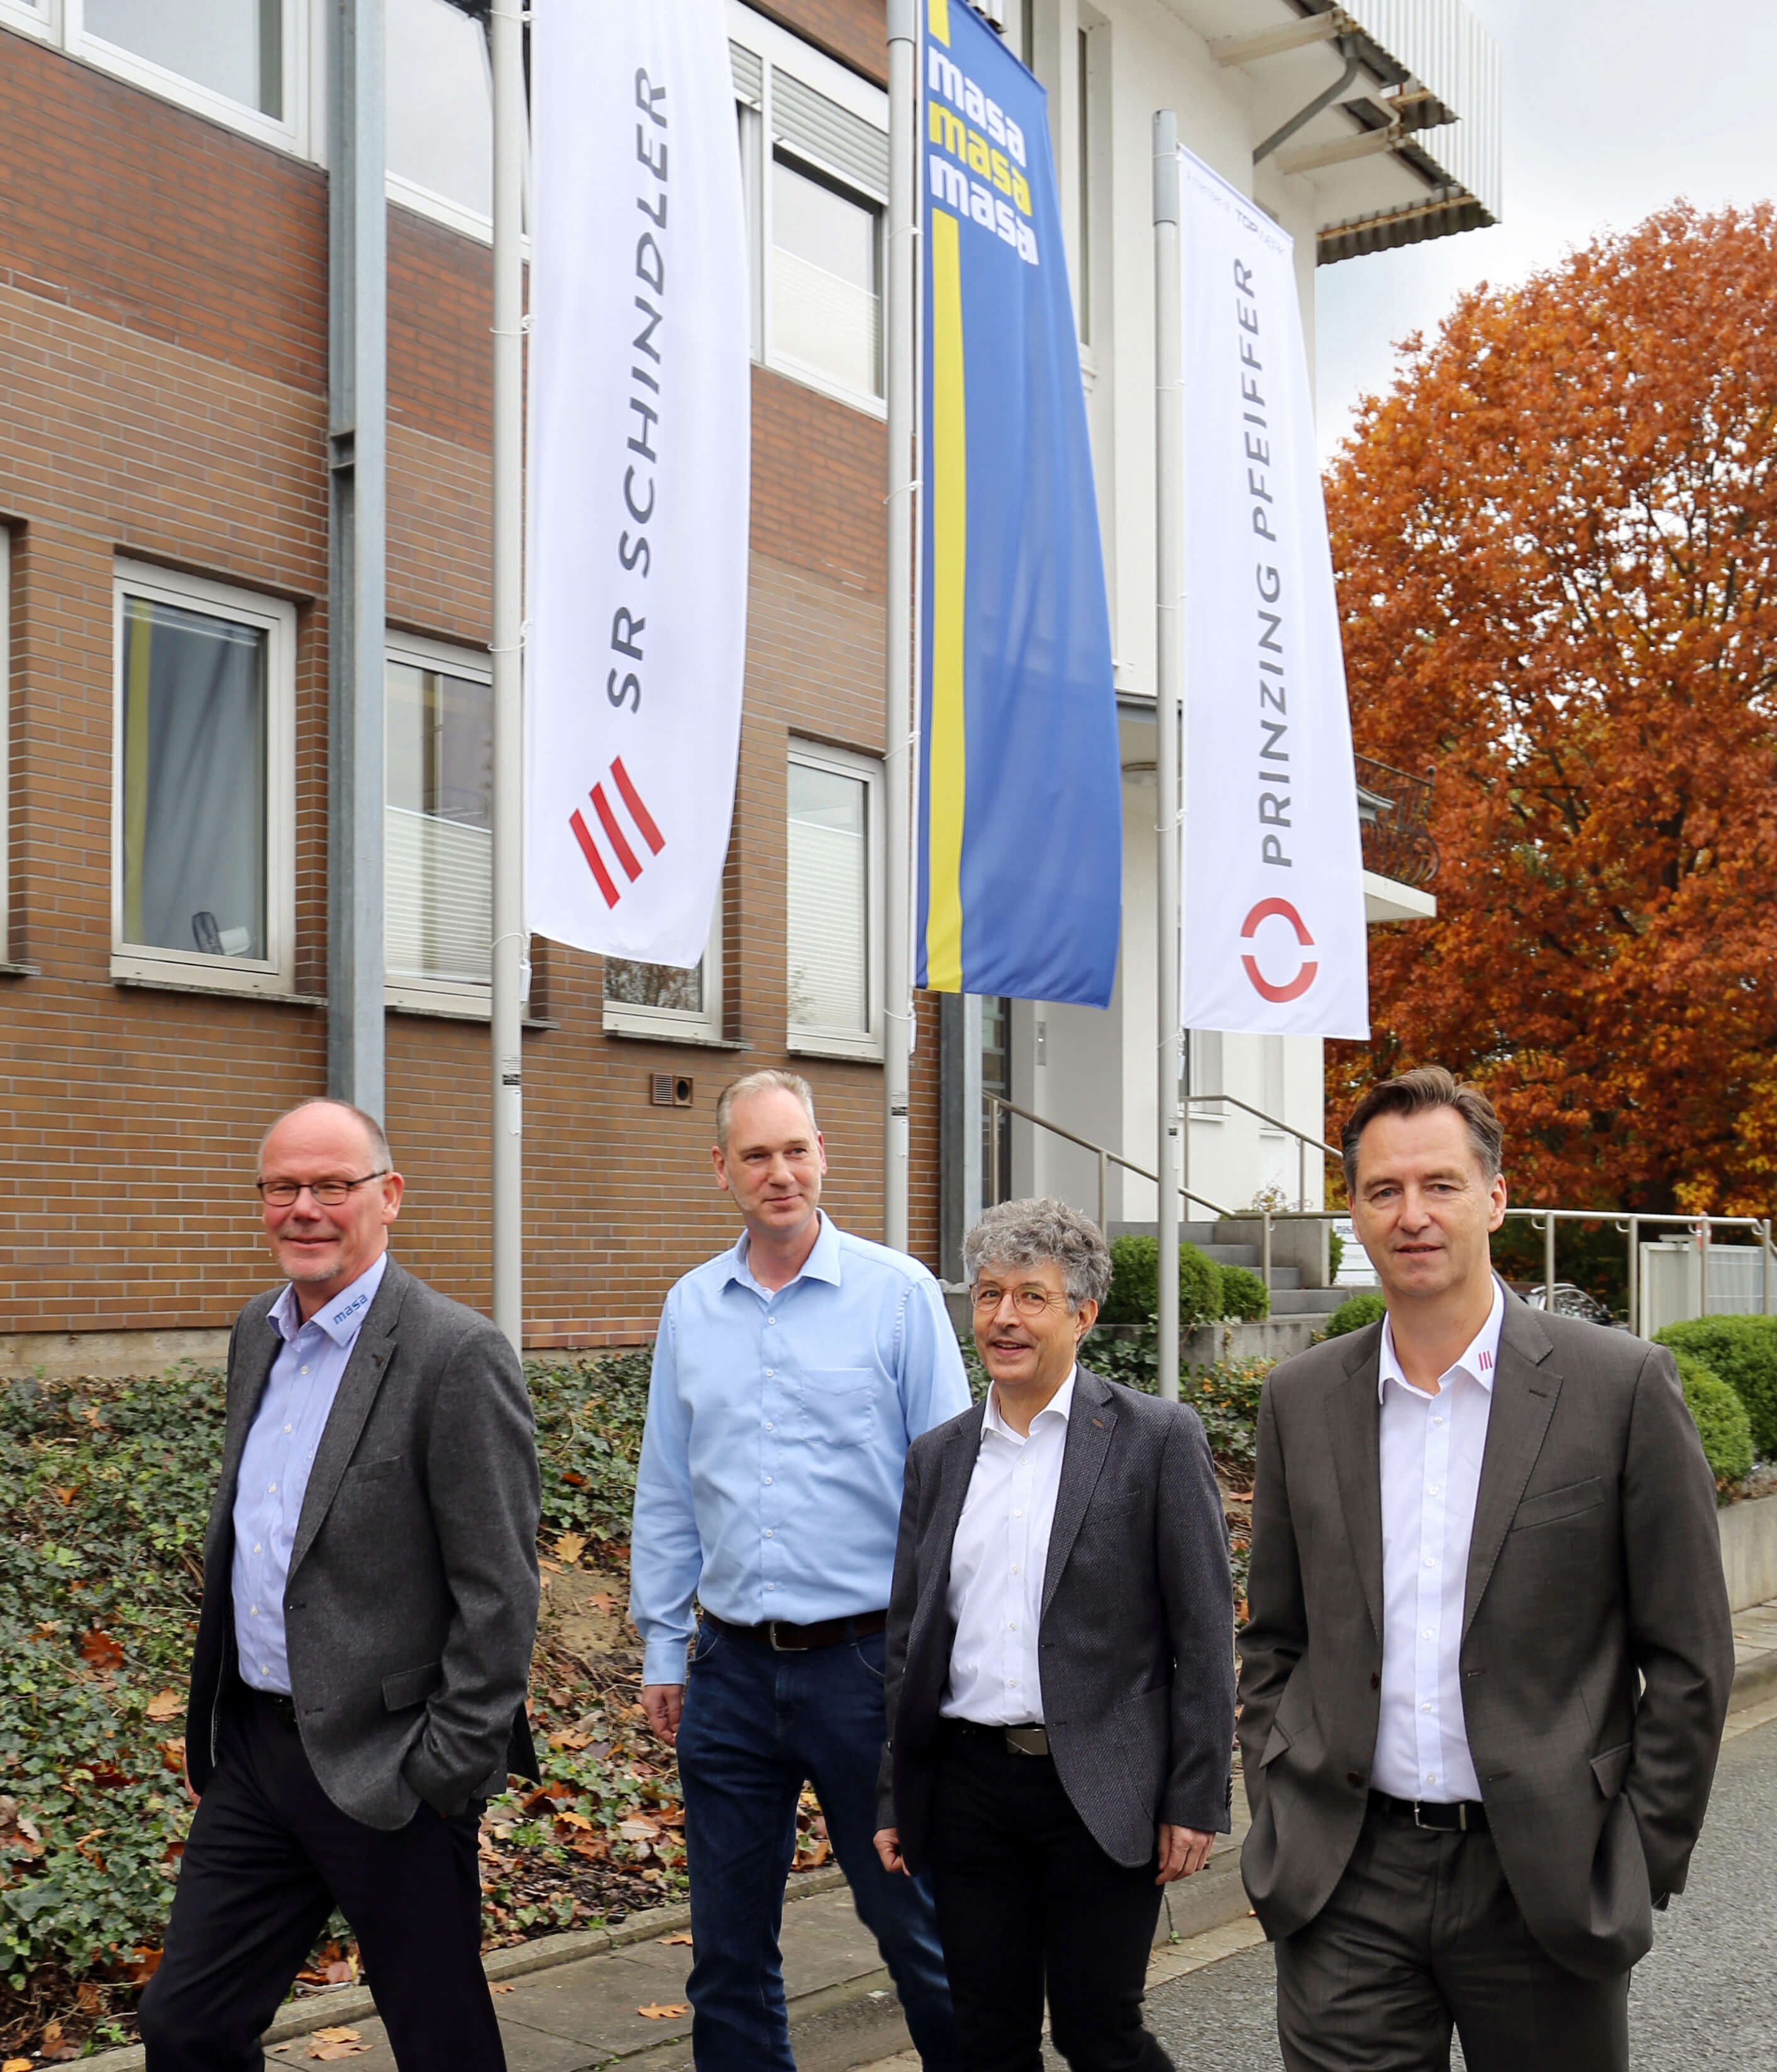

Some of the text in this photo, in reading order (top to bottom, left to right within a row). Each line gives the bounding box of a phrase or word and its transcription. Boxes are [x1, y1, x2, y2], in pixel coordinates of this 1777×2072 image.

[928, 45, 1027, 168] masa
[928, 100, 1032, 217] masa
[929, 154, 1039, 265] masa
[607, 67, 668, 714] SR SCHINDLER
[1233, 258, 1276, 542] PFEIFFER
[1256, 563, 1293, 868] PRINZING
[333, 1294, 367, 1324] masa
